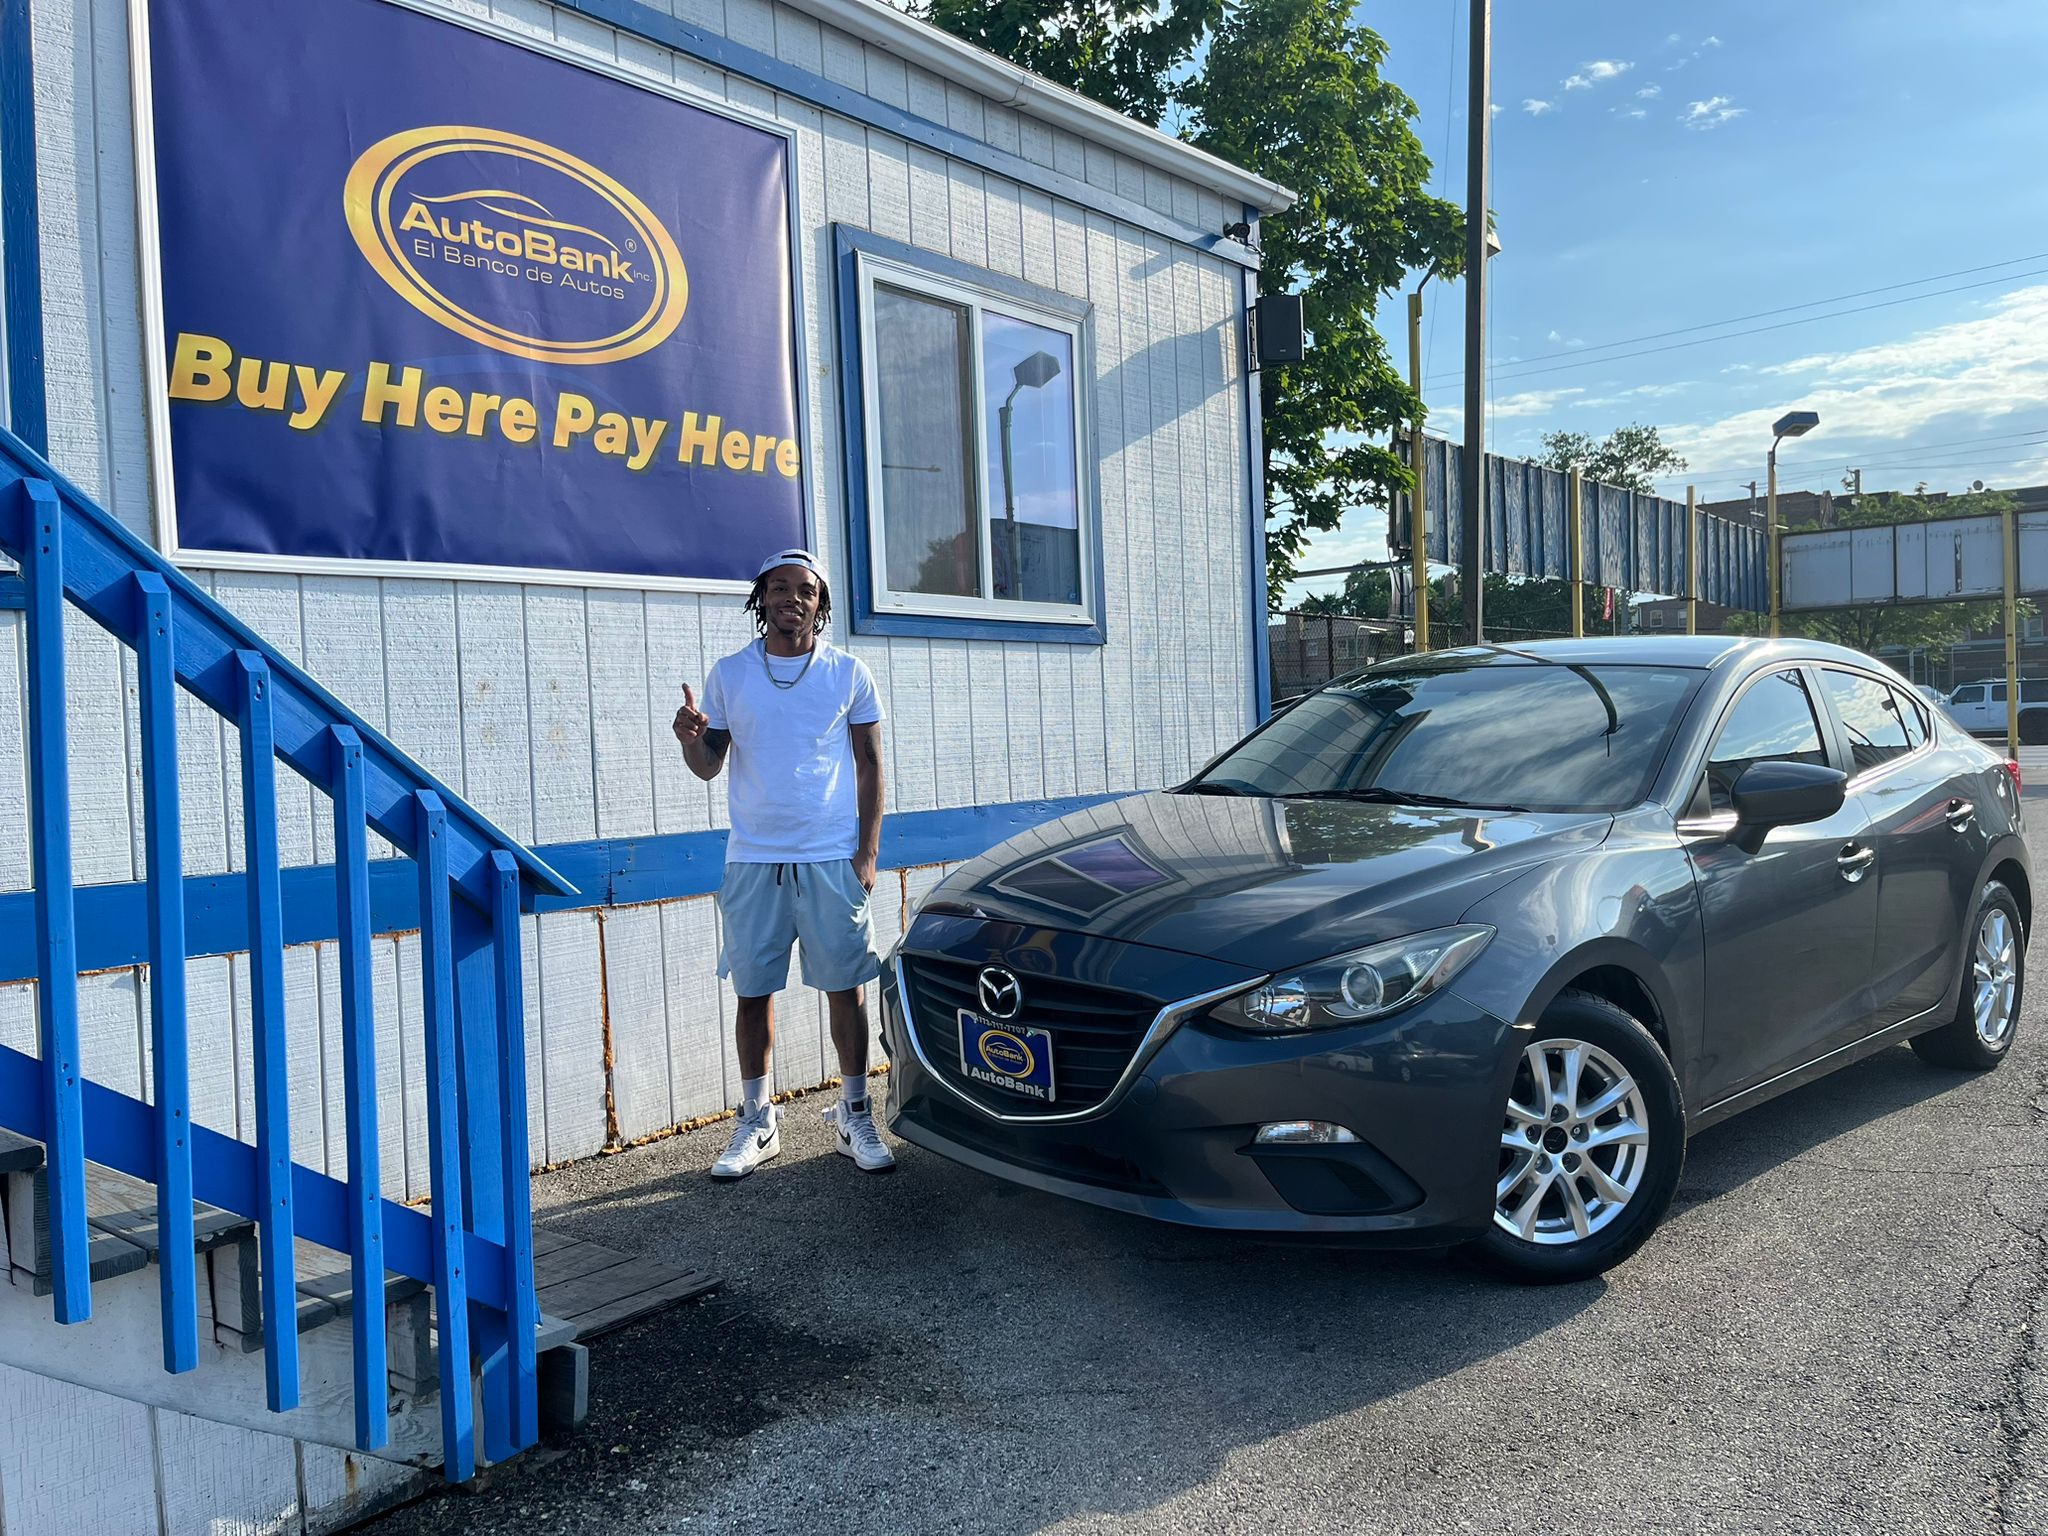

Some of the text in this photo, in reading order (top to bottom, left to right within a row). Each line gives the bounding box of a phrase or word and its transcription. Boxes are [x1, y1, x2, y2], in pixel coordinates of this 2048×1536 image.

[399, 201, 634, 283] AutoBank
[414, 238, 625, 300] El Banco de Autos
[168, 332, 799, 477] Buy Here Pay Here
[970, 1066, 1045, 1099] AutoBank
